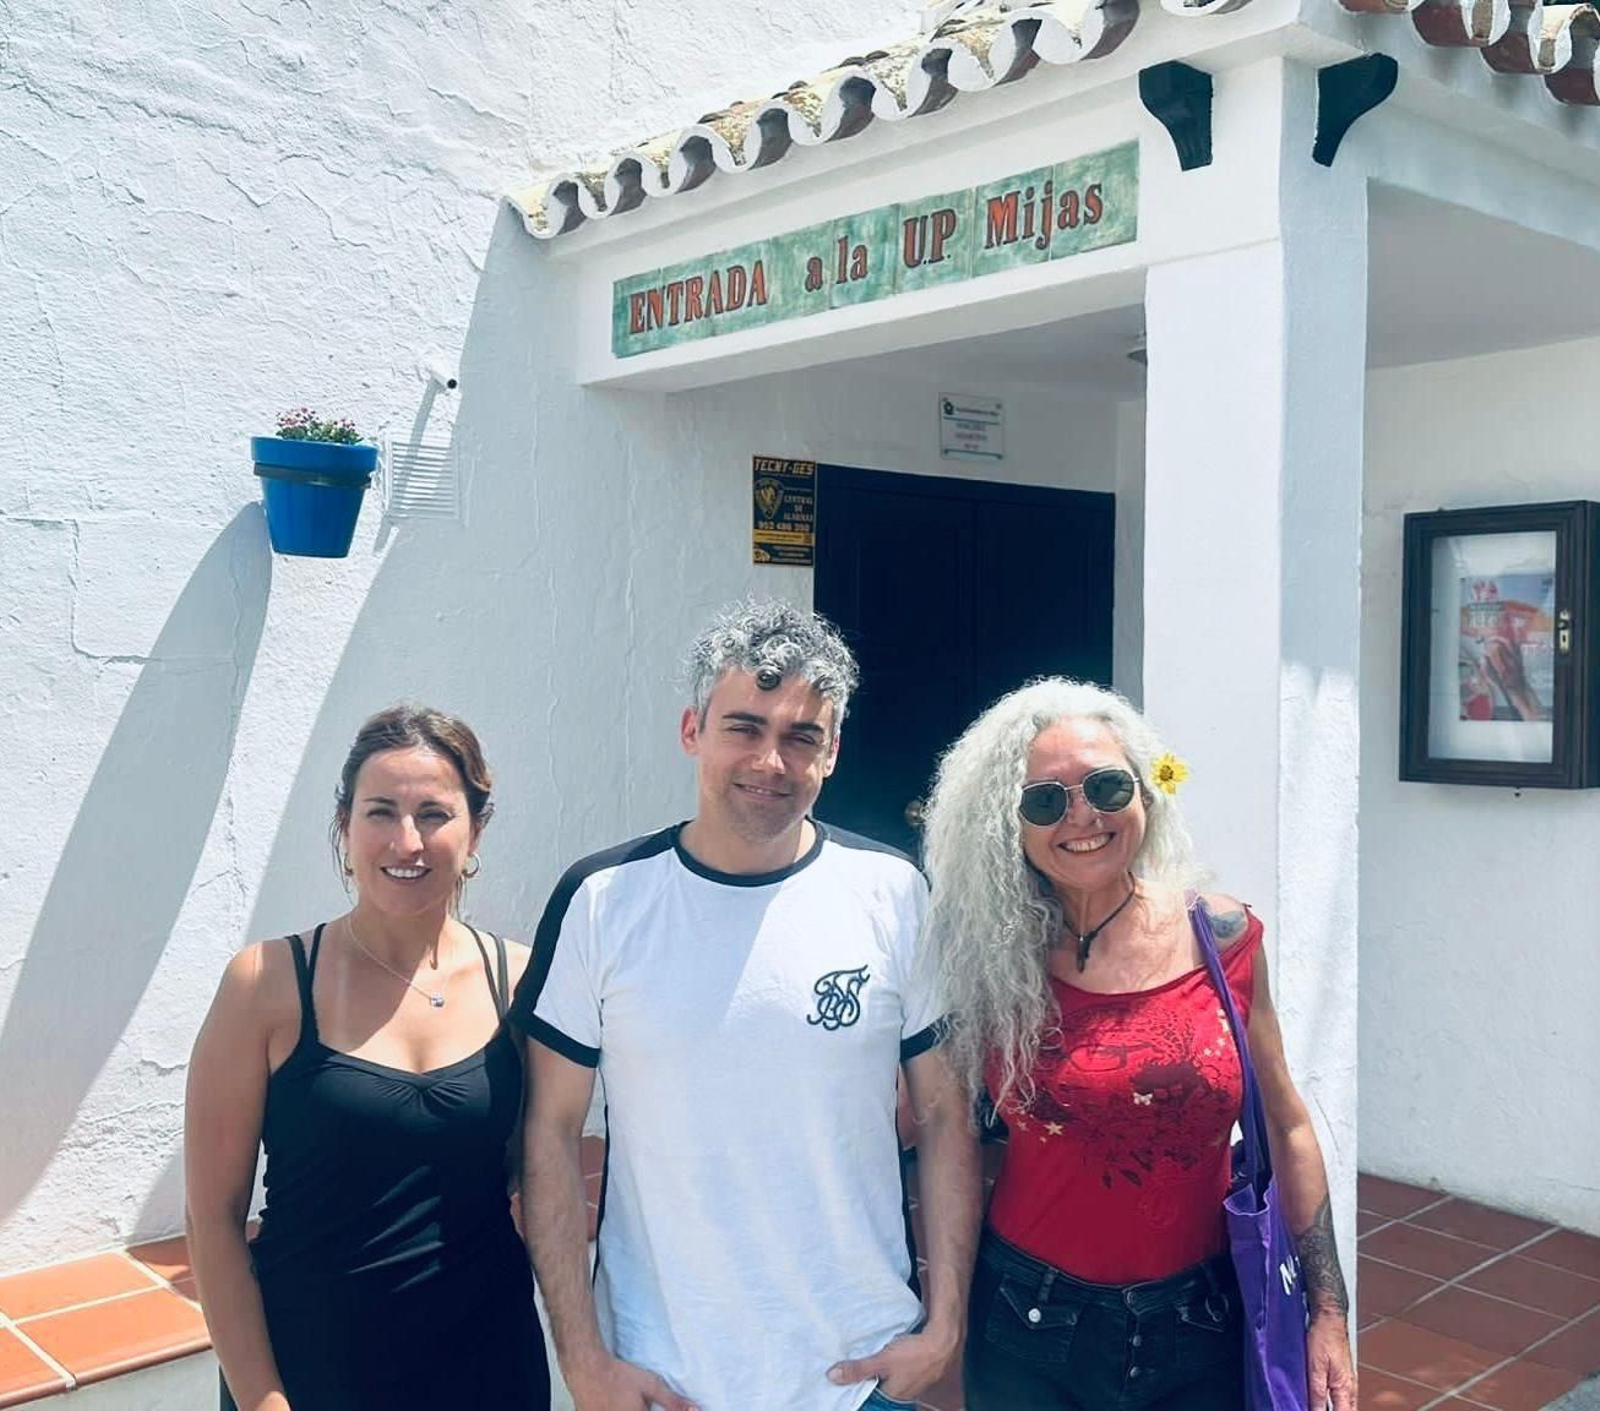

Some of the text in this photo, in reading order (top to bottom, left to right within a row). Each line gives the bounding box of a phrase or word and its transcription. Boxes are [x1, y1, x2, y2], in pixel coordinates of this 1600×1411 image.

[629, 260, 767, 334] ENTRADA
[805, 254, 823, 293] a
[837, 236, 868, 285] la
[985, 180, 1104, 250] Mijas
